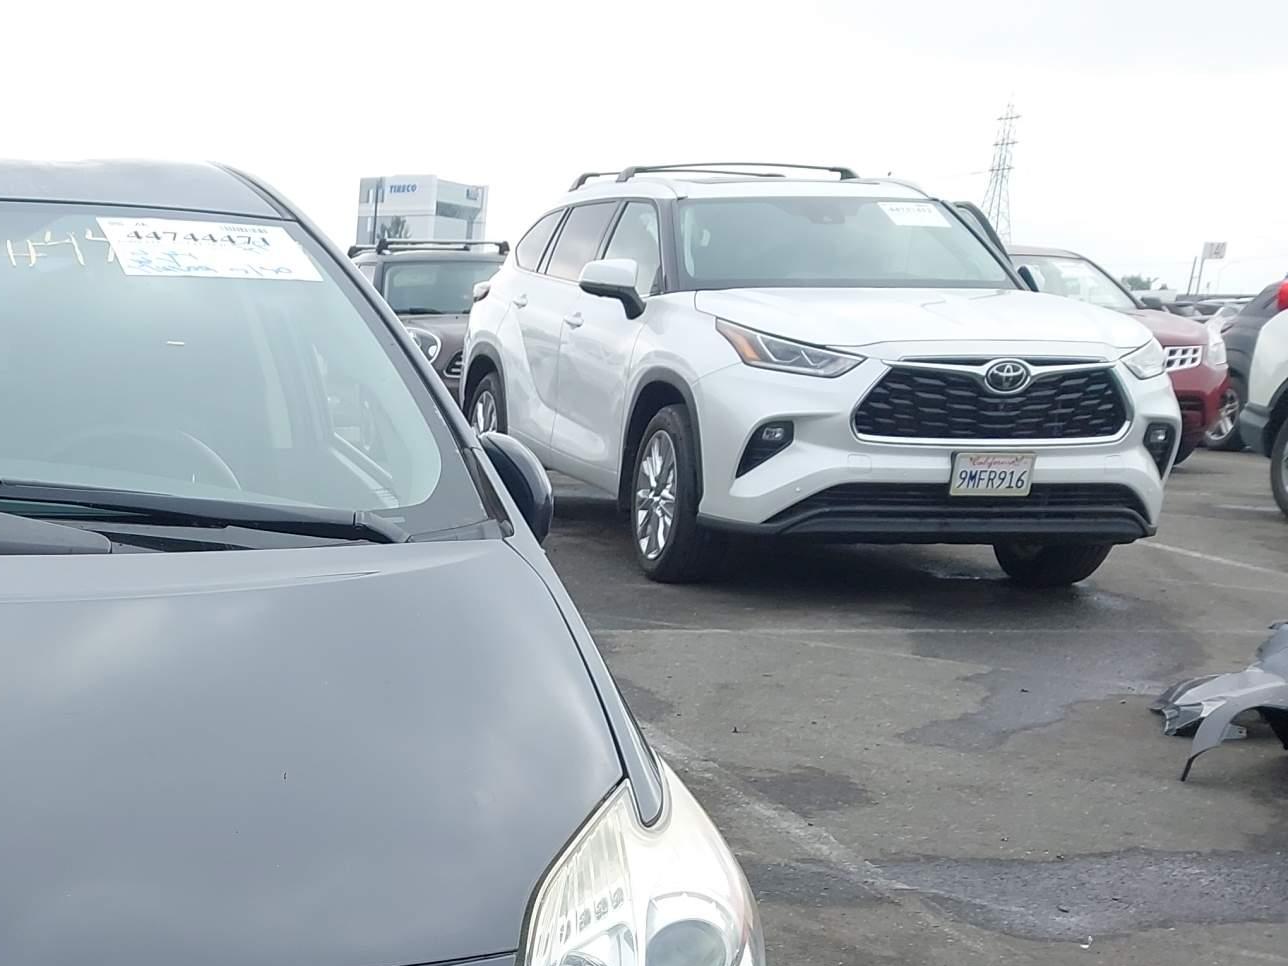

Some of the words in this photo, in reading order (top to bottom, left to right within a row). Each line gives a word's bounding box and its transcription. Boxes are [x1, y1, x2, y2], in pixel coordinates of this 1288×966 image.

[126, 230, 270, 247] 44744471
[968, 455, 1019, 468] California
[956, 470, 1028, 489] 9MFR916
